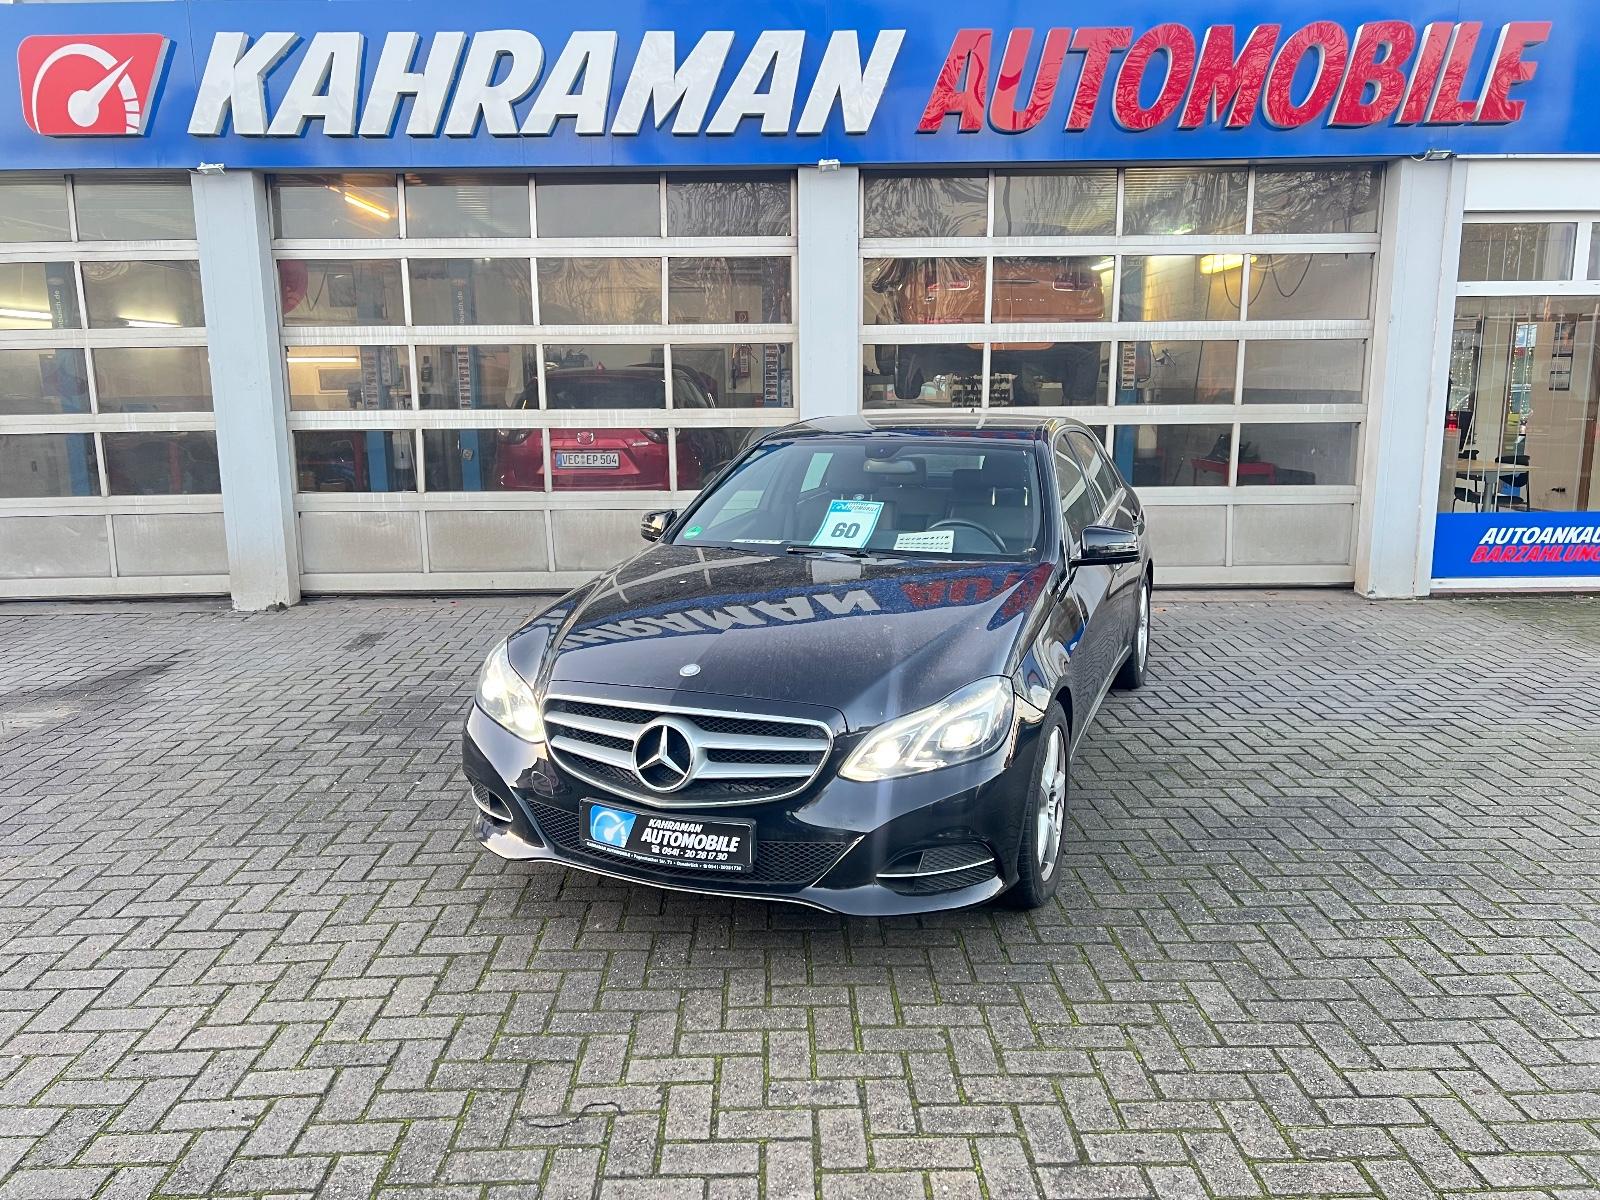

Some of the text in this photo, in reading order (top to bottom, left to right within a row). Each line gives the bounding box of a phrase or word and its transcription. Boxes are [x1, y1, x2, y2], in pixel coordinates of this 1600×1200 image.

[187, 20, 1552, 136] KAHRAMAN AUTOMOBILE
[562, 454, 617, 465] VEC EP 504
[831, 522, 861, 539] 60
[648, 818, 703, 833] KAHRAMAN
[641, 827, 740, 852] AUTOMOBILE
[662, 846, 680, 856] 0541
[685, 850, 695, 858] 20
[696, 851, 707, 859] 28
[707, 852, 716, 860] 17
[716, 853, 728, 861] 30
